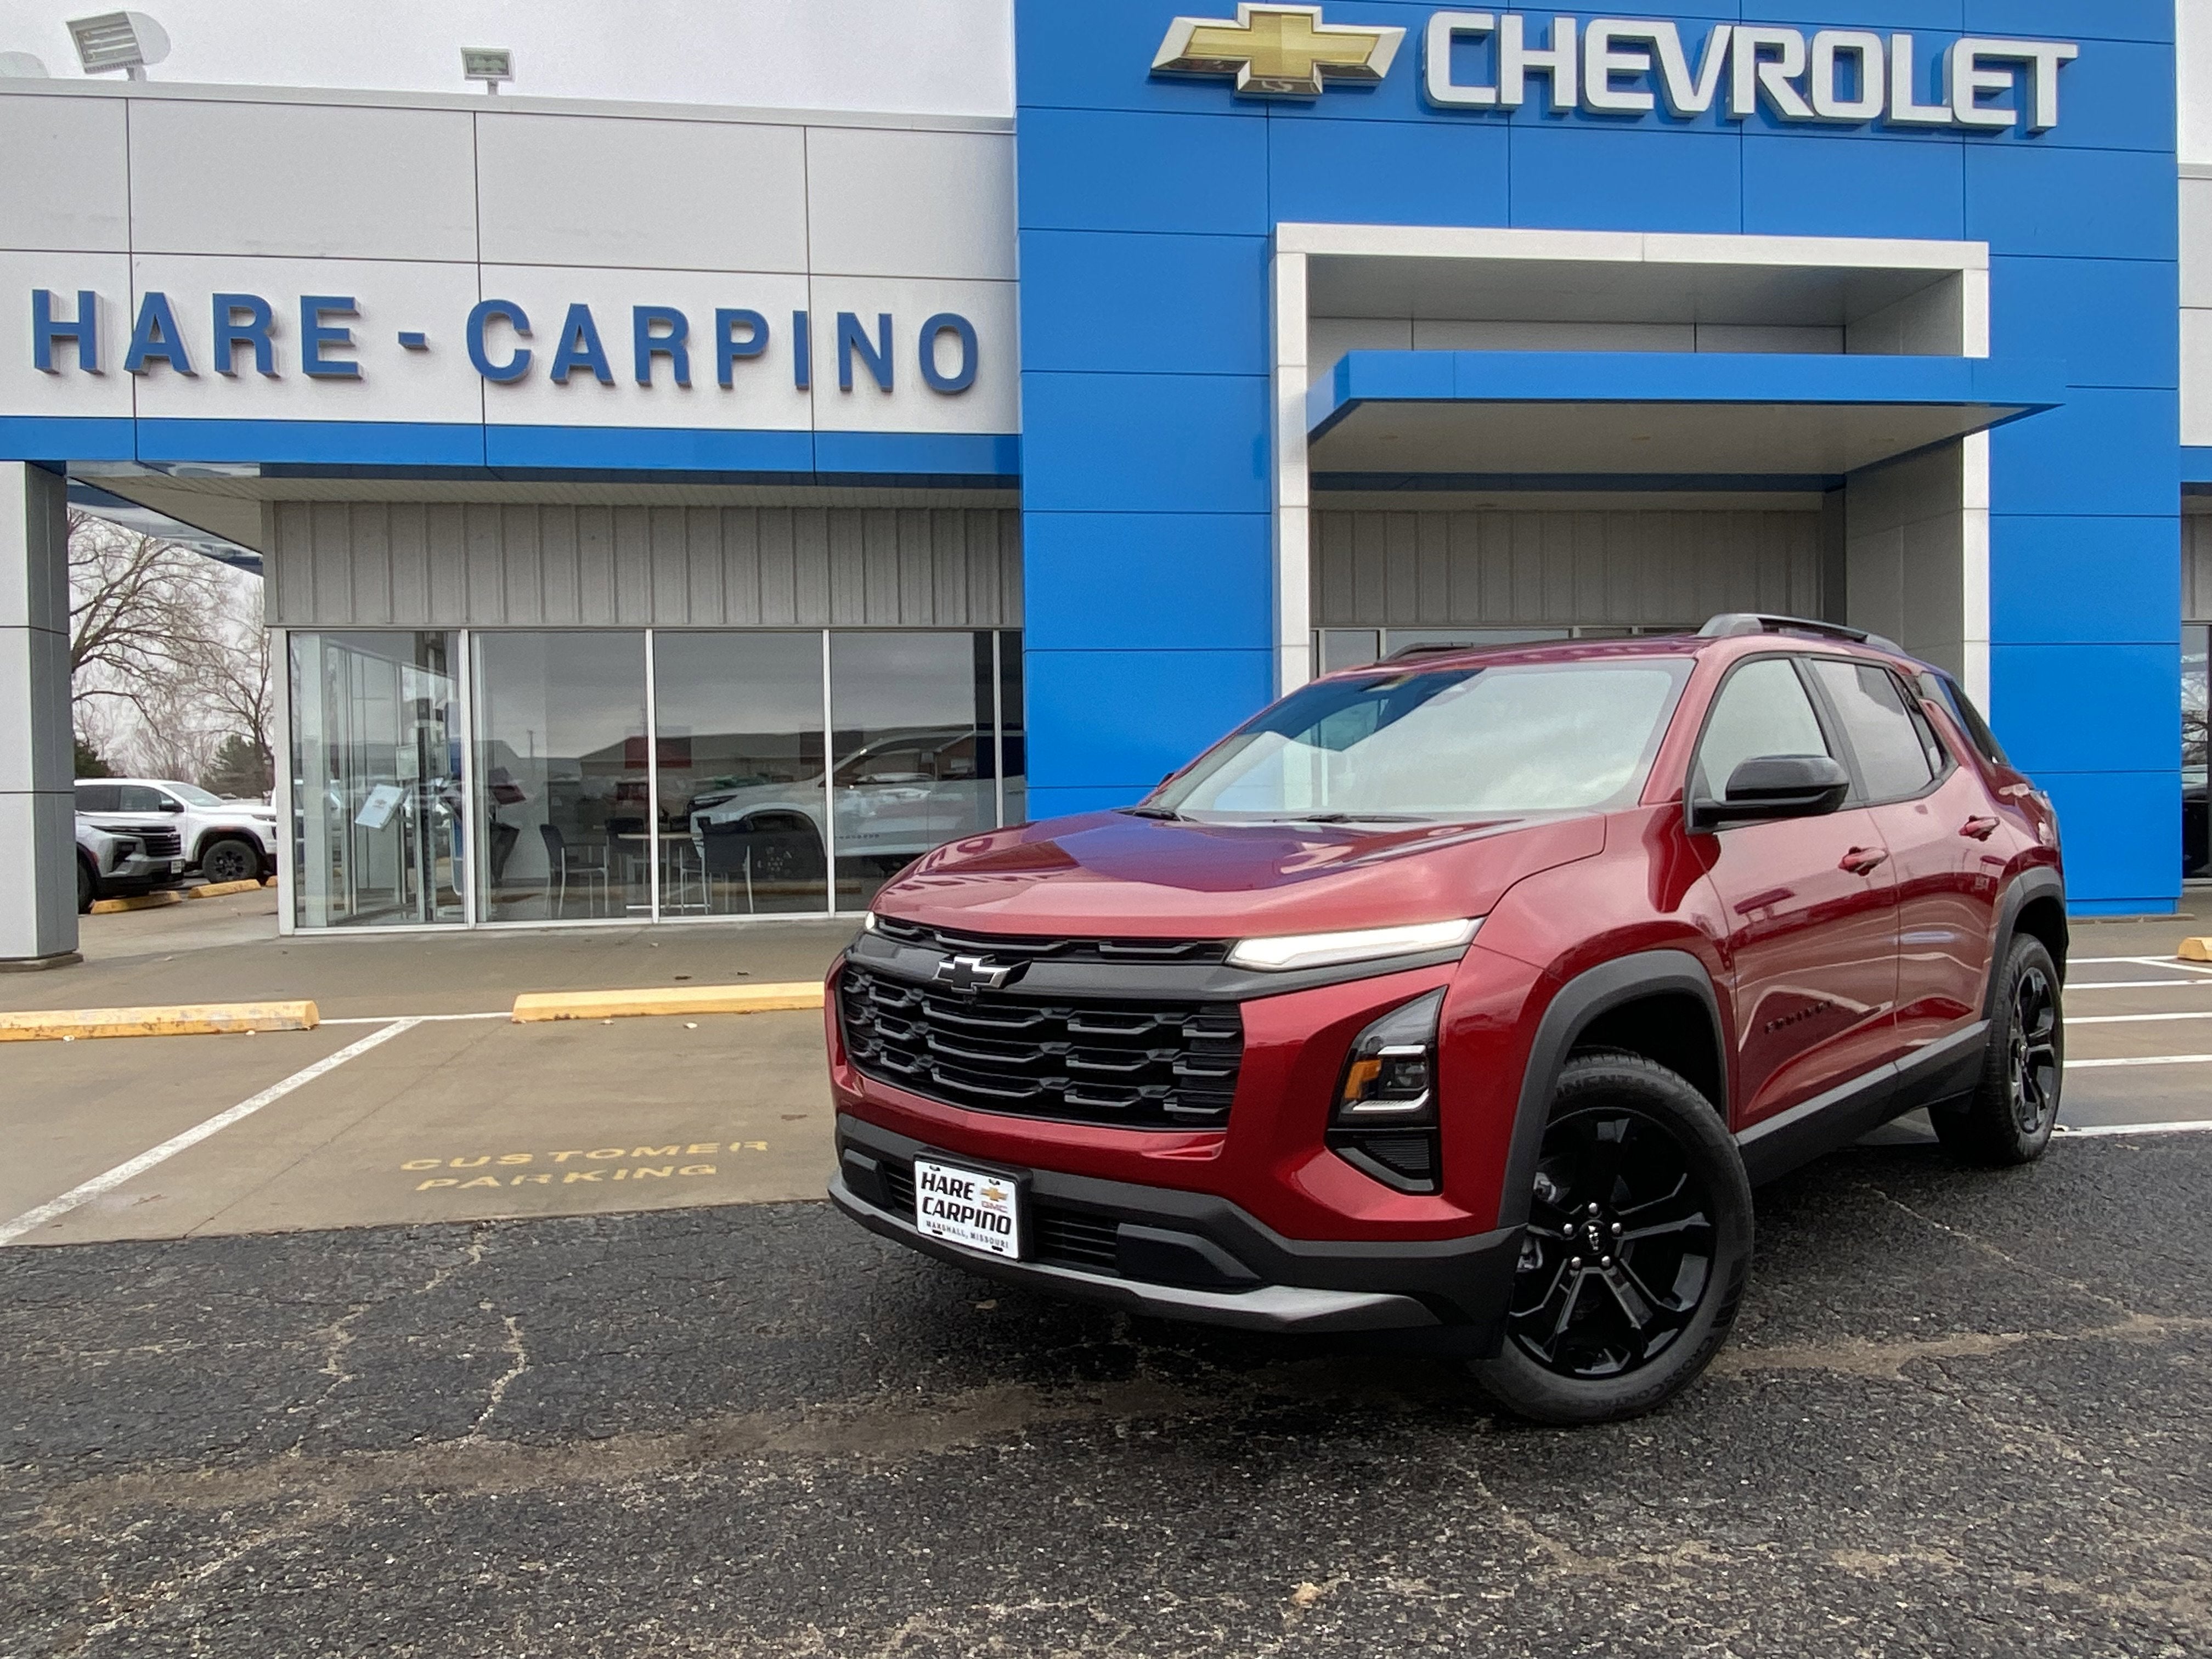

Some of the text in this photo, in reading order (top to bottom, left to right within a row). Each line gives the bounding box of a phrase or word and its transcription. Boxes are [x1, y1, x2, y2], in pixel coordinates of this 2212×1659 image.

[1423, 10, 2079, 133] CHEVROLET
[32, 289, 363, 381] HARE
[466, 298, 979, 396] CARPINO
[400, 1141, 769, 1171] CUSTOMER
[414, 1165, 718, 1191] PARKING
[921, 1171, 975, 1201] HARE
[922, 1197, 1012, 1235] CARPINO
[970, 1232, 1009, 1249] MISSOURI
